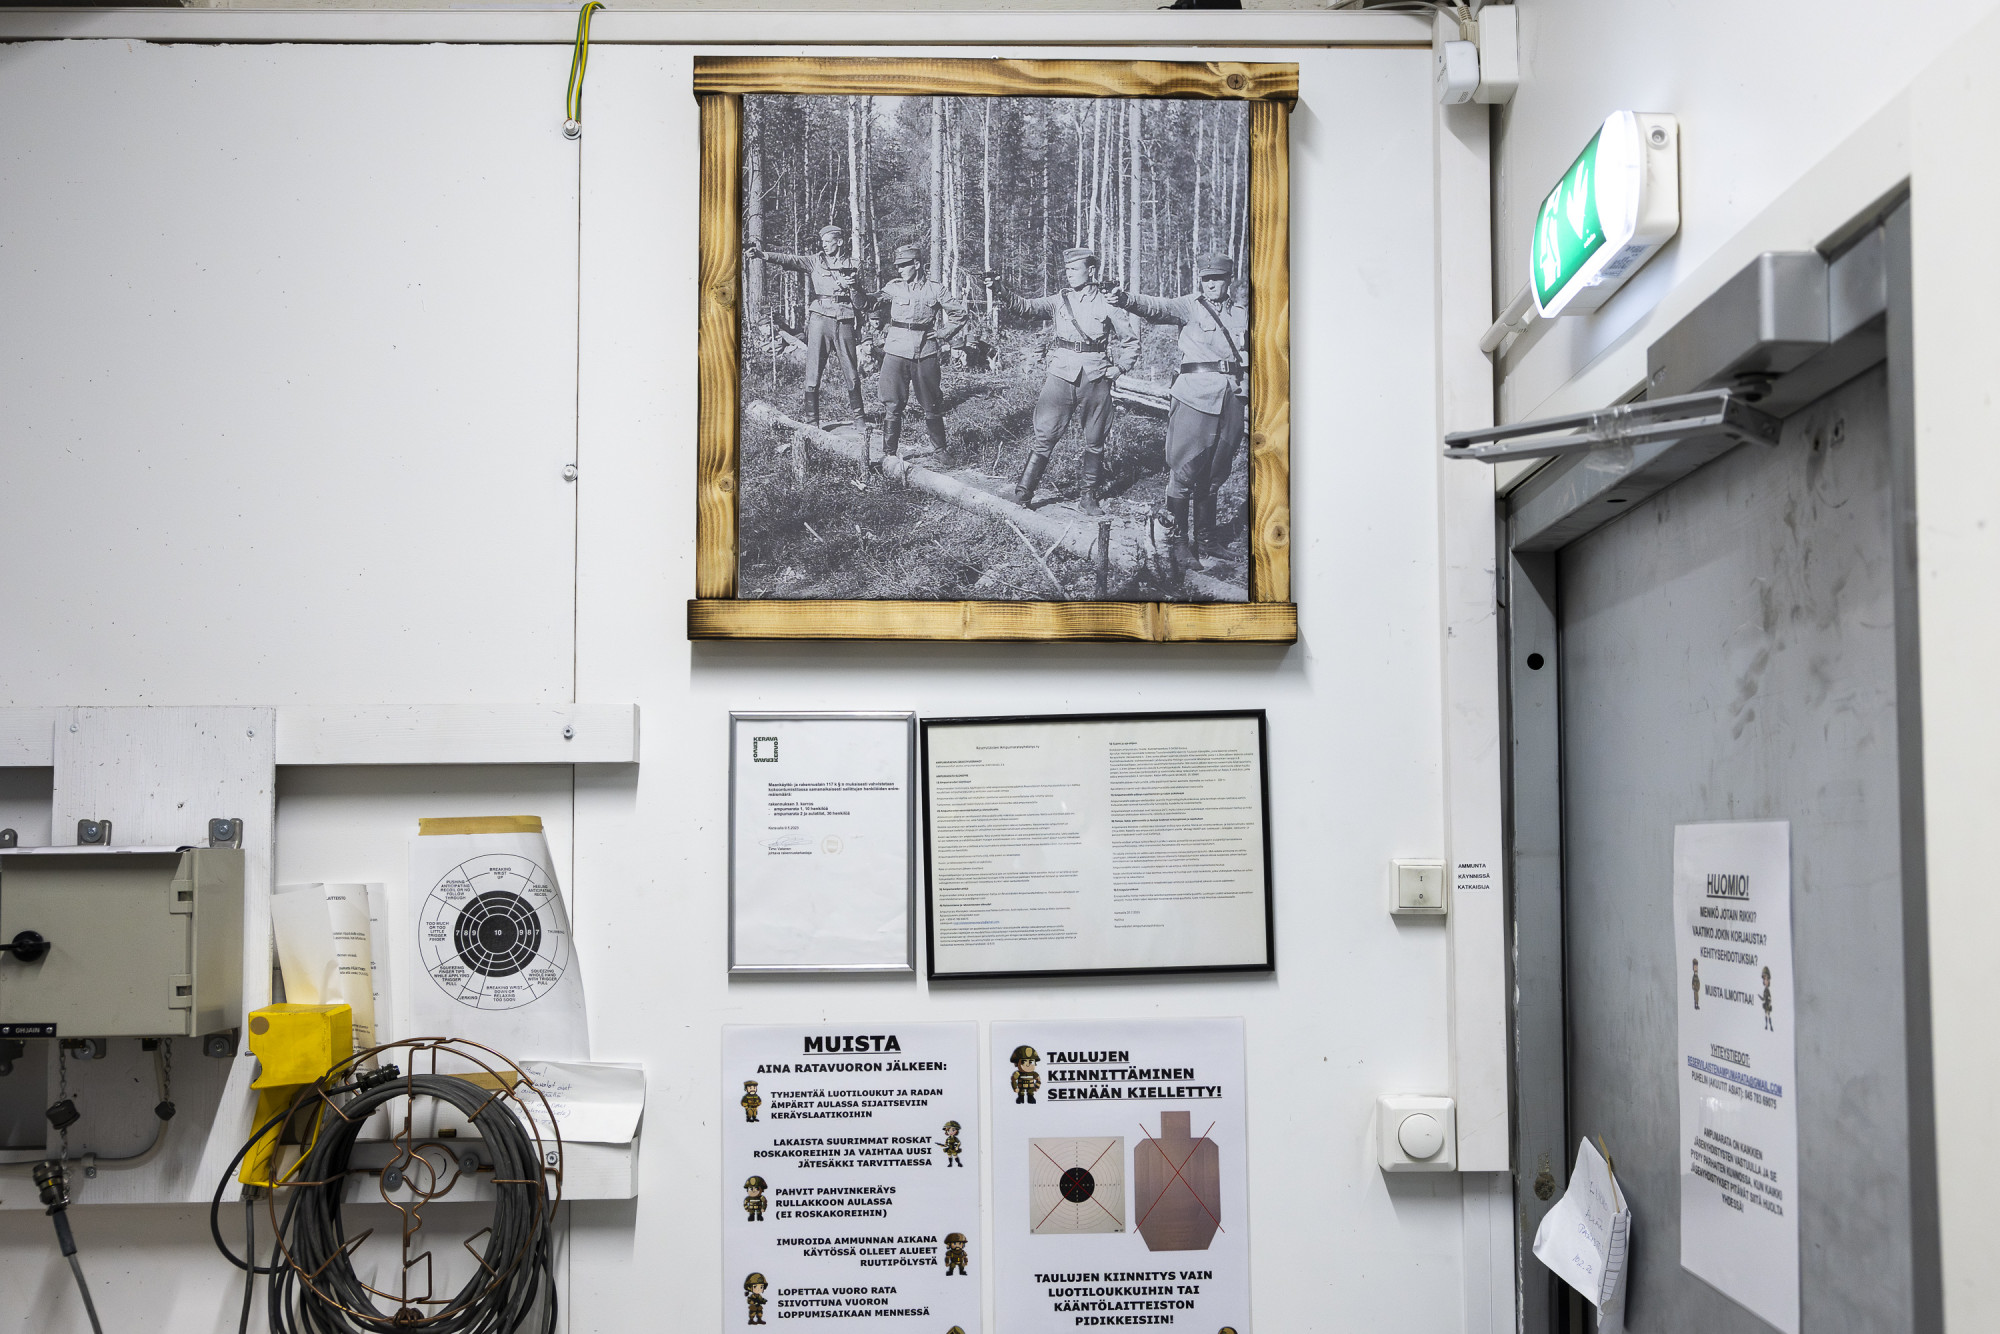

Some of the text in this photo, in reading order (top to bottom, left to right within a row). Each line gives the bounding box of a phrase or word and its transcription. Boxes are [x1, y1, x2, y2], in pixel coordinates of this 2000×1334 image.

[1707, 874, 1750, 897] HUOMIO!
[1700, 906, 1757, 924] MENIKÖ JOTAIN RIKKI?
[1692, 925, 1767, 946] VAATIIKO JOKIN KORJAUSTA?
[1700, 946, 1758, 967] KEHITYSEHDOTUKSIA?
[1705, 984, 1755, 1006] MUISTA ILMOITTAA!
[804, 1035, 901, 1053] MUISTA
[1047, 1051, 1130, 1063] TAULUJEN
[1711, 1043, 1751, 1068] YHTEYSTIEDOT:
[757, 1061, 947, 1074] AINA RATAVUORON JÄLKEEN:
[1048, 1066, 1195, 1082] KIINNITTÄMINEN
[1692, 1070, 1708, 1085] PUHELIN
[771, 1089, 825, 1099] TYHJENTÄÄ
[828, 1090, 893, 1098] LUOTILOUKUT
[910, 1089, 943, 1097] RADAN
[1048, 1085, 1222, 1100] SEINÄÄN KIELLETTY!
[771, 1100, 928, 1109] ÄMPÄRIT AULASSA SIJAITSEVIIN
[771, 1110, 873, 1120] KERÄYSLAATIKOIHIN
[773, 1138, 824, 1147] LAKAISTA
[826, 1137, 889, 1146] SUURIMMAT
[1704, 1127, 1763, 1161] AMPUMARATA ON KAIKKIEN
[753, 1148, 932, 1158] ROSKAKOREIHIN JA VAIHTAA UUSI
[797, 1159, 932, 1169] JÄTESÄKKI TARVITTAESSA
[1735, 1156, 1761, 1176] VASTUULLA
[1763, 1168, 1769, 1179] JA
[1770, 1170, 1777, 1183] SE
[1691, 1148, 1703, 1162] PYSYY
[1753, 1179, 1764, 1192] KUN
[1765, 1184, 1783, 1201] KAIKKI
[775, 1185, 896, 1197] PAHVIT PAHVINKERÄYS
[775, 1198, 893, 1208] RULLAKKOON AULASSA
[1763, 1198, 1784, 1216] HUOLTA
[775, 1209, 888, 1220] (EI ROSKAKOREIHIN)
[776, 1236, 937, 1246] IMUROIDA AMMUNNAN AIKANA
[803, 1247, 937, 1257] KÄYTÖSSÄ OLLEET ALUEET
[860, 1257, 938, 1267] RUUTIPÖLYSTÄ
[1035, 1271, 1213, 1283] TAULUJEN KIINNITYS VAIN
[778, 1286, 897, 1297] LOPETTAA VUORO RATA
[1048, 1286, 1200, 1298] LUOTILOUKKUIHIN TAI
[777, 1298, 889, 1308] SIIVOTTUNA VUORON
[1054, 1300, 1195, 1312] KÄÄNTÖLAITTEISTON
[778, 1308, 930, 1319] LOPPUMISAIKAAN MENNESSÄ
[1075, 1315, 1174, 1326] PIDIKKEISIIN!
